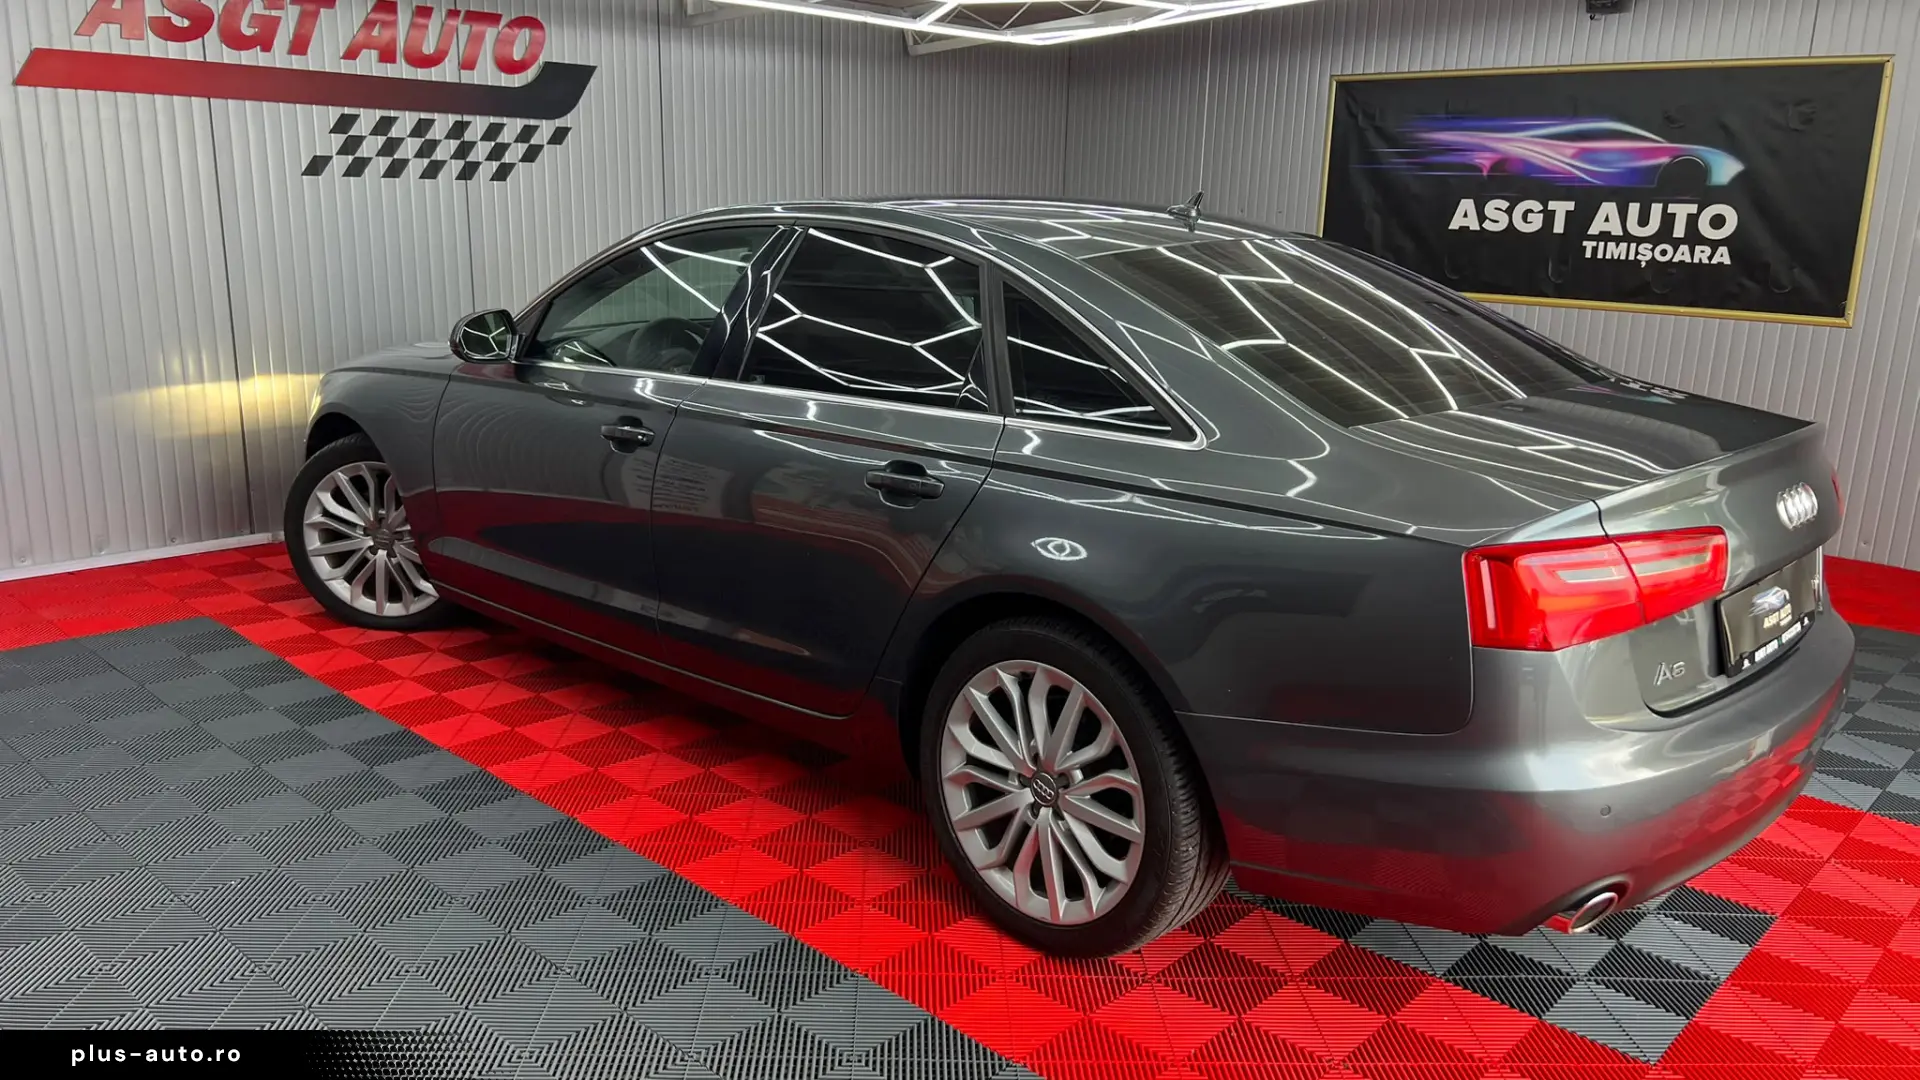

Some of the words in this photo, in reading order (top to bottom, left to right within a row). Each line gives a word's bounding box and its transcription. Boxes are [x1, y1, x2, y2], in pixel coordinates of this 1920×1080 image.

[74, 0, 337, 56] ASGT
[340, 0, 546, 75] AUTO
[1448, 199, 1575, 234] ASGT
[1587, 202, 1738, 240] AUTO
[1582, 240, 1731, 268] TIMIȘOARA
[1653, 662, 1685, 685] A6
